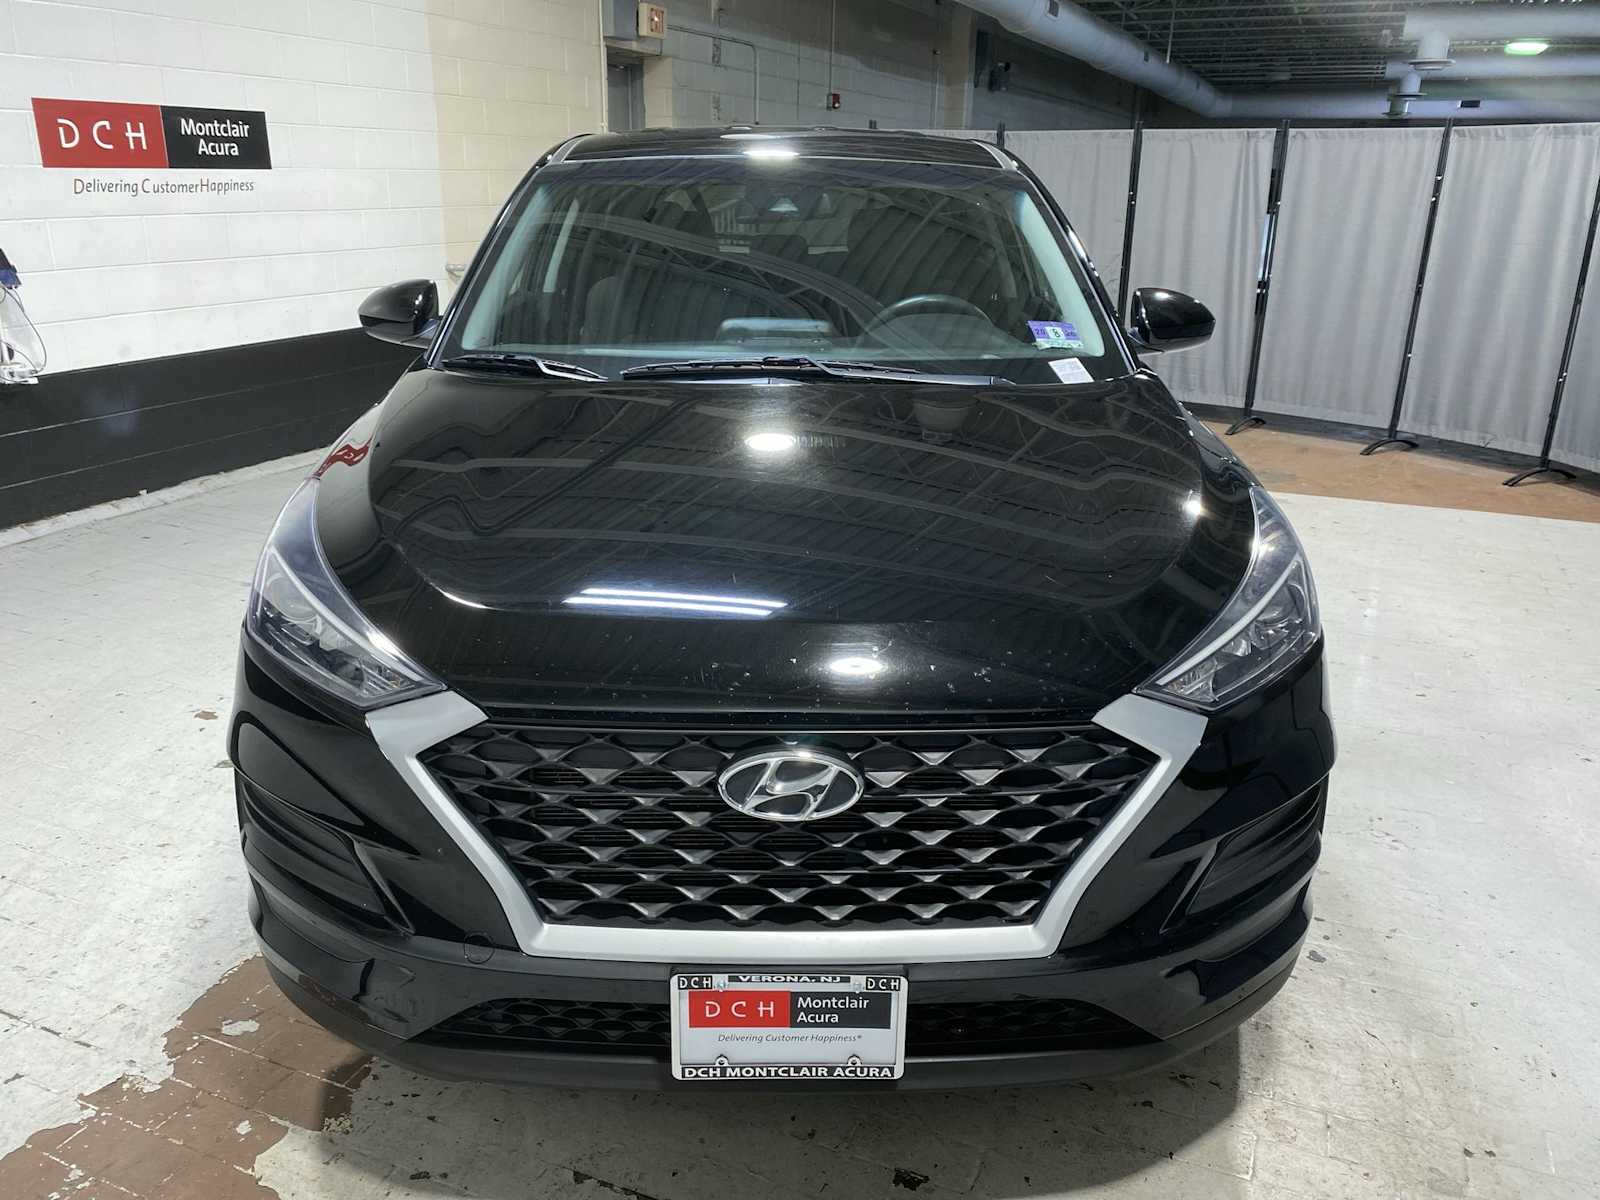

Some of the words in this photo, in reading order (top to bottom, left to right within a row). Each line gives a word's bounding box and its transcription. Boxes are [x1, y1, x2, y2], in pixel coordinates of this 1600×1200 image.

[56, 118, 148, 150] DCH
[180, 117, 250, 138] Montclair
[198, 138, 240, 156] Acura
[73, 177, 138, 197] Delivering
[141, 177, 200, 194] Customer
[200, 177, 255, 195] Happiness
[679, 976, 712, 989] DCH
[866, 977, 900, 990] DCH
[704, 1000, 775, 1018] DCH
[797, 995, 870, 1009] Montclair
[796, 1010, 840, 1024] Acura
[718, 1033, 763, 1044] Delivering
[765, 1033, 810, 1043] Customer
[683, 1066, 721, 1079] DCH
[725, 1066, 829, 1078] MONTCLAIR
[832, 1066, 892, 1078] ACURA
